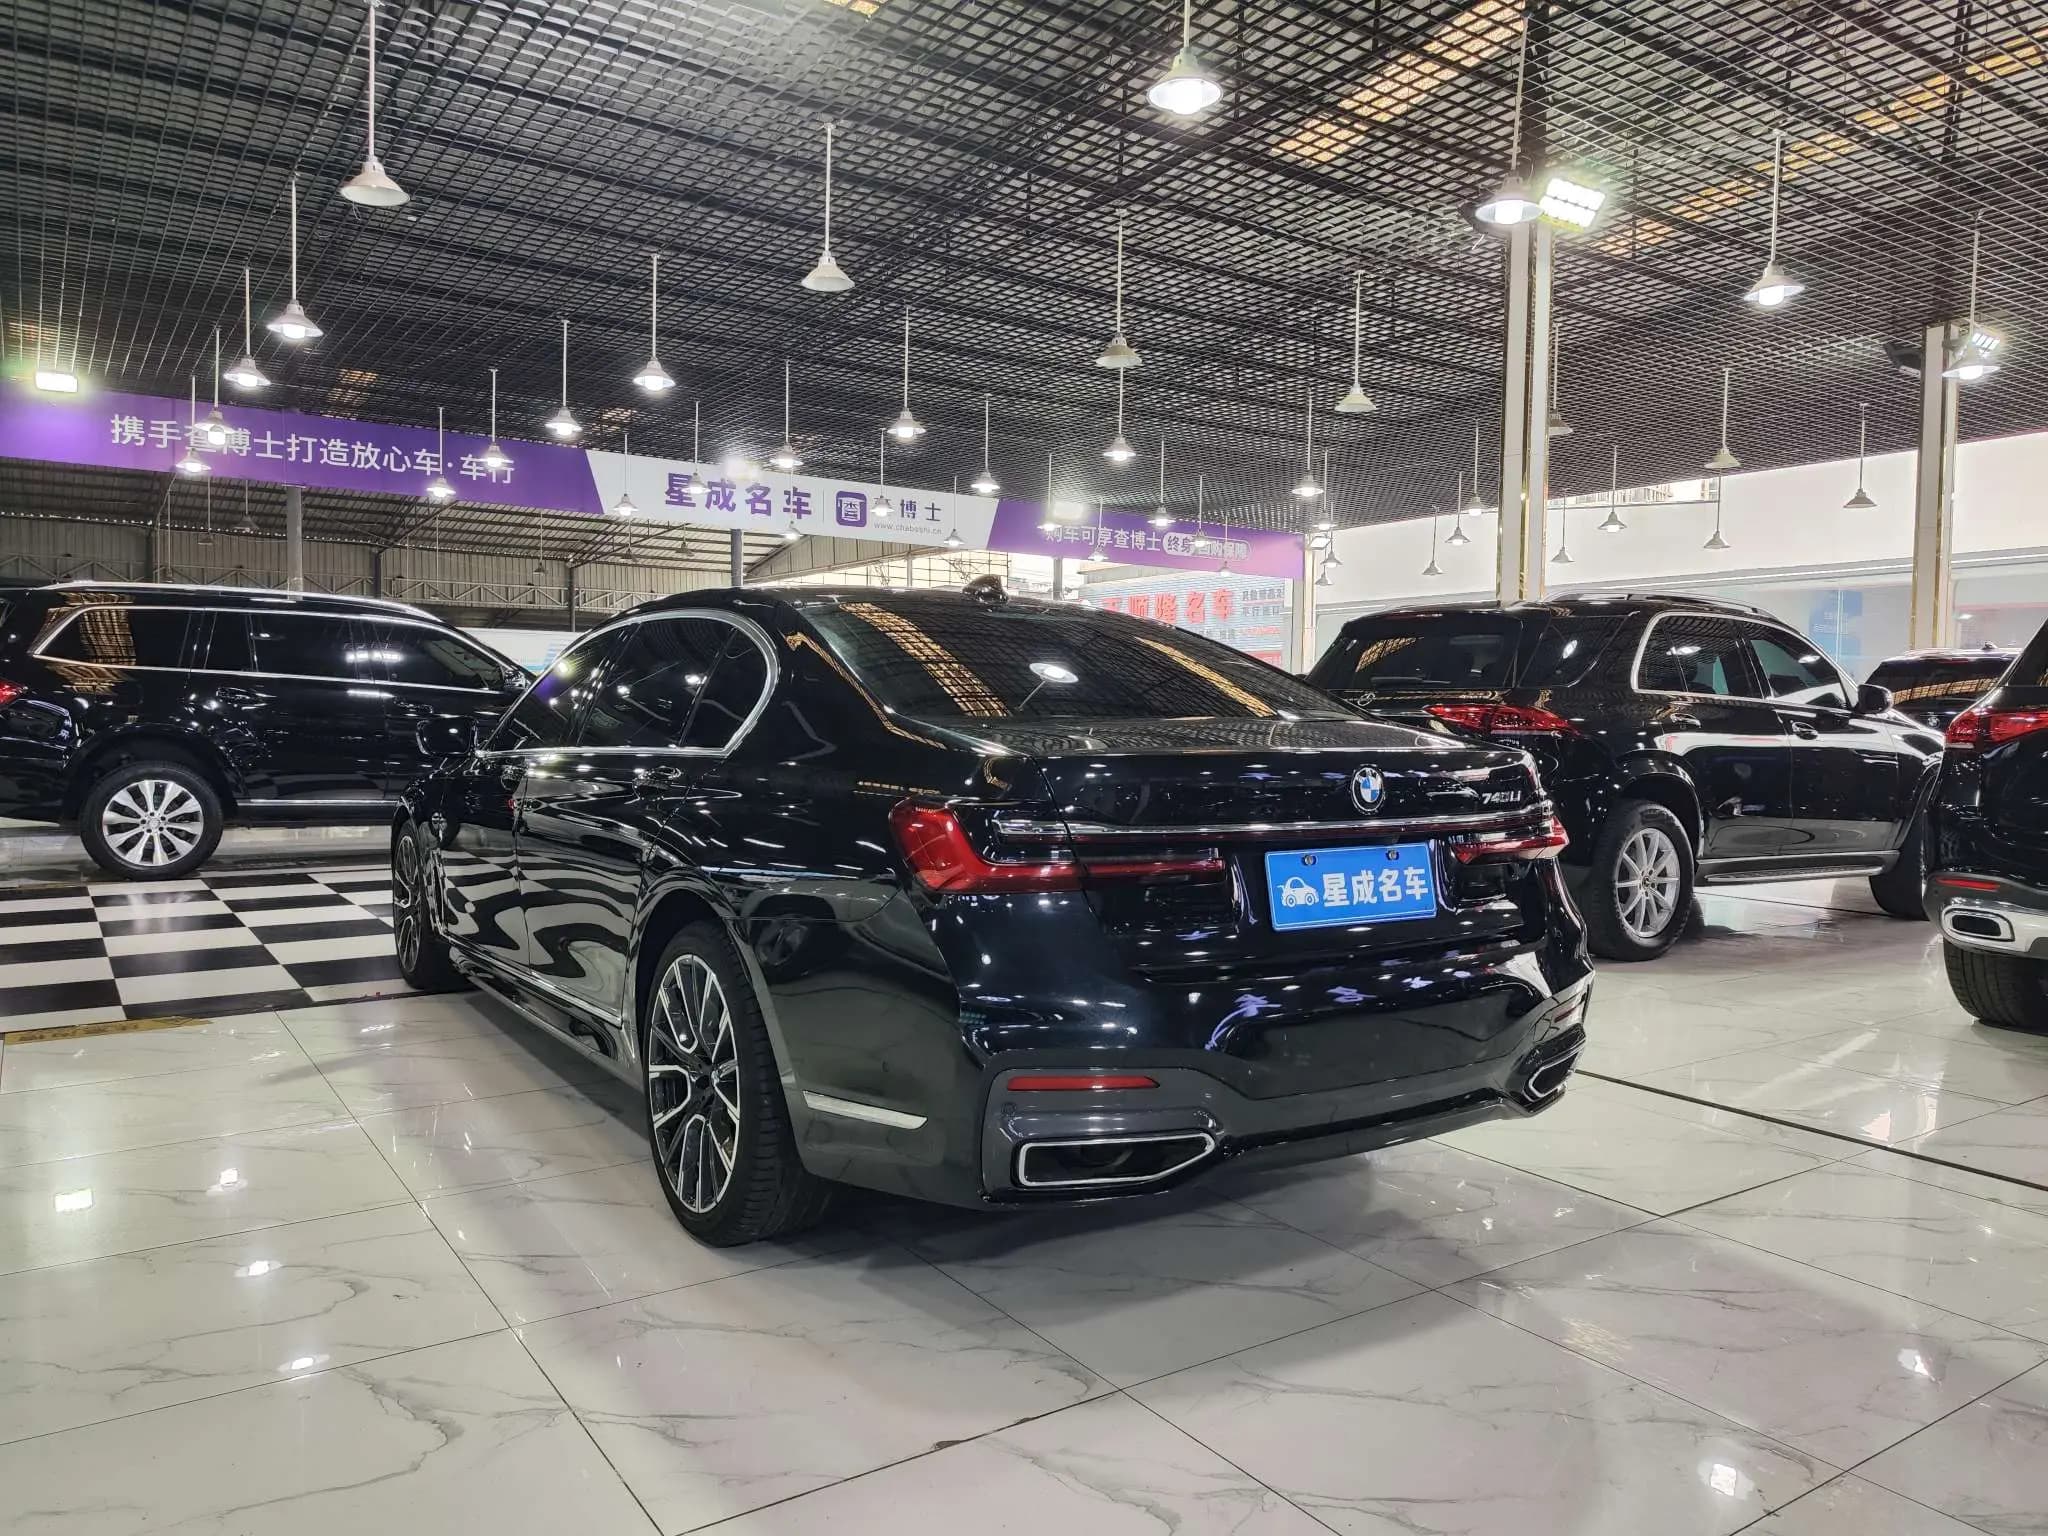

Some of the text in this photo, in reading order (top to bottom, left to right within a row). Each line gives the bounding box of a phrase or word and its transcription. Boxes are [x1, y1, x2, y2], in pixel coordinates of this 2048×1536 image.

[664, 472, 813, 520] 星成名车
[1322, 866, 1429, 908] 星成名车
